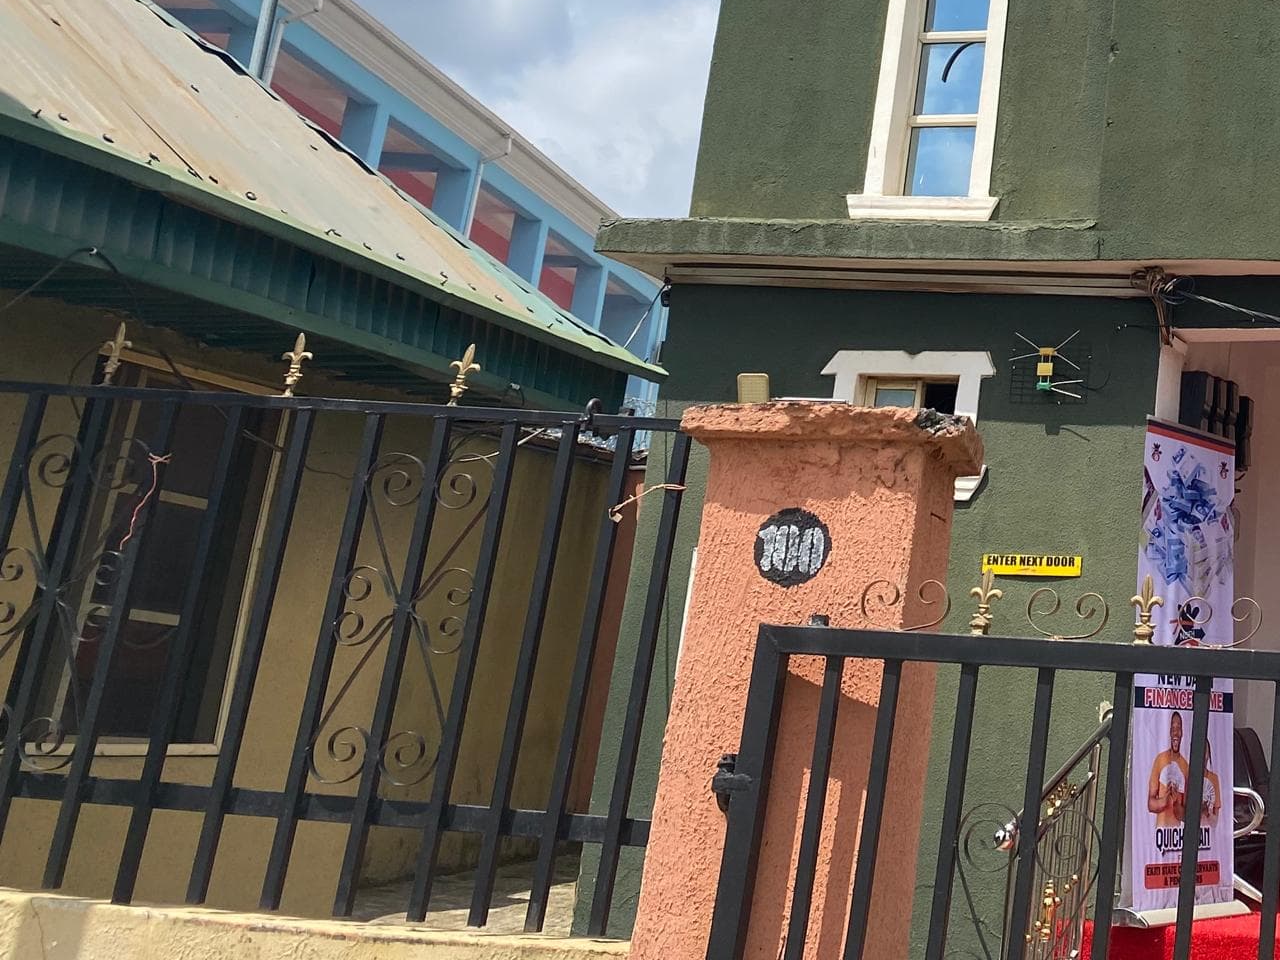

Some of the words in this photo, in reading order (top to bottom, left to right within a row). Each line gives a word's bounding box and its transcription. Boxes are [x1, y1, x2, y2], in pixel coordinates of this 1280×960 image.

[986, 555, 1017, 566] ENTER
[1019, 556, 1045, 566] NEXT
[1045, 556, 1075, 567] DOOR
[1158, 674, 1181, 687] NEW
[1144, 687, 1194, 709] FINANCE
